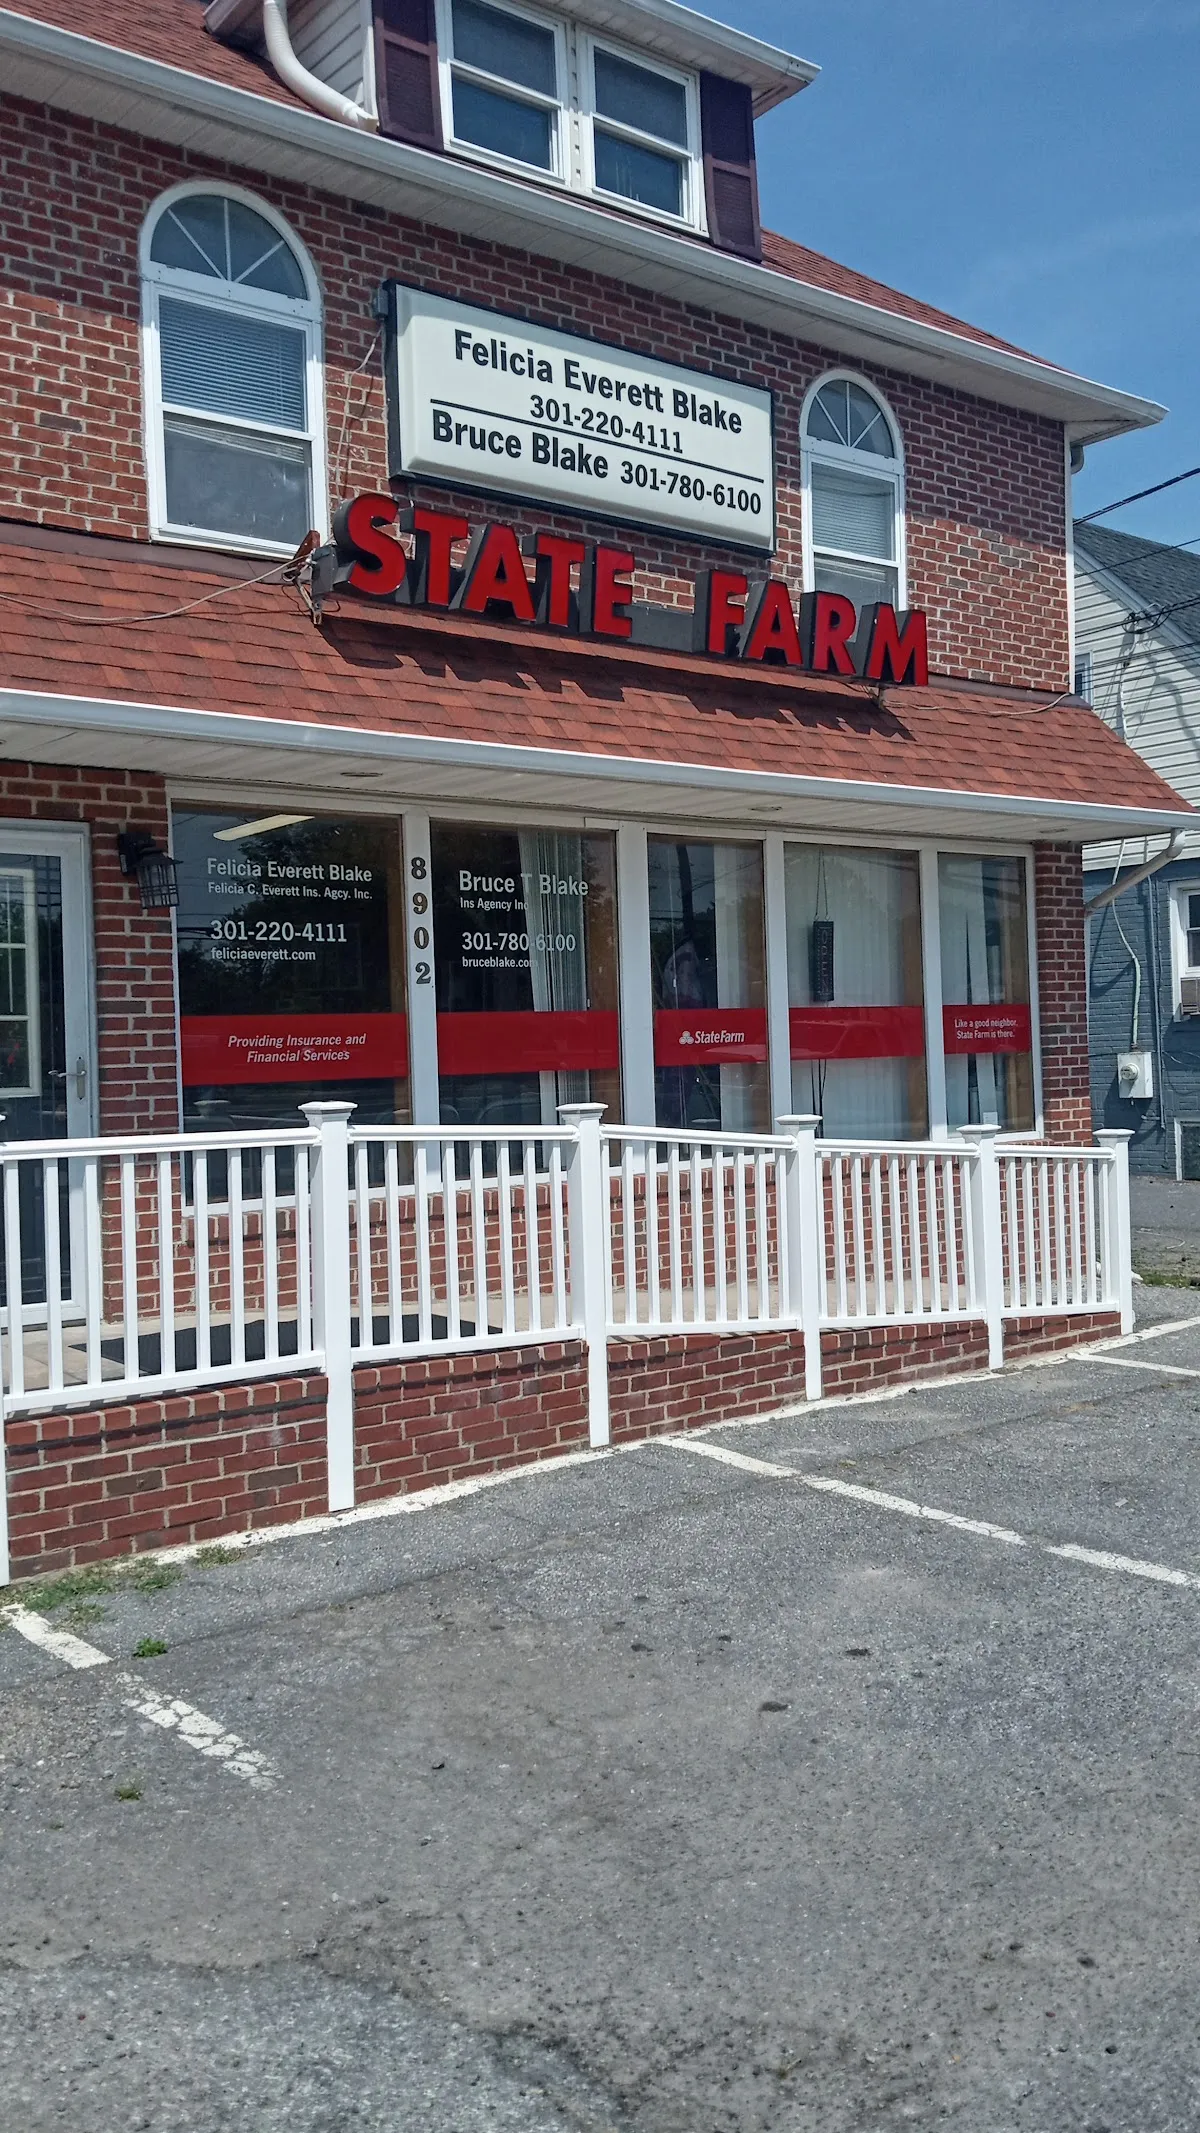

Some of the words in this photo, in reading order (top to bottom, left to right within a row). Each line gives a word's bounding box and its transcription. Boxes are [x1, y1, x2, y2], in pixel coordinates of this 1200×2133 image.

[454, 328, 553, 384] Felicia
[563, 358, 664, 414] Everett
[672, 388, 742, 434] Blake
[529, 394, 683, 454] 301-220-4111
[432, 408, 522, 459] Bruce
[532, 431, 609, 479] Blake
[620, 460, 762, 515] 301-780-6100
[335, 493, 635, 638] STATE
[699, 569, 928, 687] FARM
[207, 857, 262, 877] Felicia
[267, 861, 325, 881] Everett
[329, 864, 373, 882] Blake
[208, 881, 244, 894] Felicia
[247, 883, 259, 895] C.
[262, 884, 300, 897] Everett
[302, 885, 321, 898] Ins.
[324, 886, 351, 901] Agcy.
[354, 888, 373, 900] Inc.
[459, 869, 515, 893] Bruce
[520, 872, 532, 893] T
[539, 873, 589, 896] Blake
[460, 897, 475, 909] Ins
[477, 897, 512, 912] Agency
[210, 919, 348, 943] 301-220-4111
[461, 931, 576, 952] 301-780-6100
[210, 946, 317, 961] feliciaeverett.com
[954, 1019, 968, 1028] Like
[974, 1018, 990, 1029] good
[228, 1034, 284, 1049] Providing
[286, 1034, 342, 1047] Insurance
[345, 1033, 367, 1045] and
[956, 1030, 973, 1039] State
[974, 1030, 990, 1039] Farm
[990, 1030, 996, 1038] is
[247, 1050, 300, 1063] Financial
[303, 1049, 350, 1062] Services
